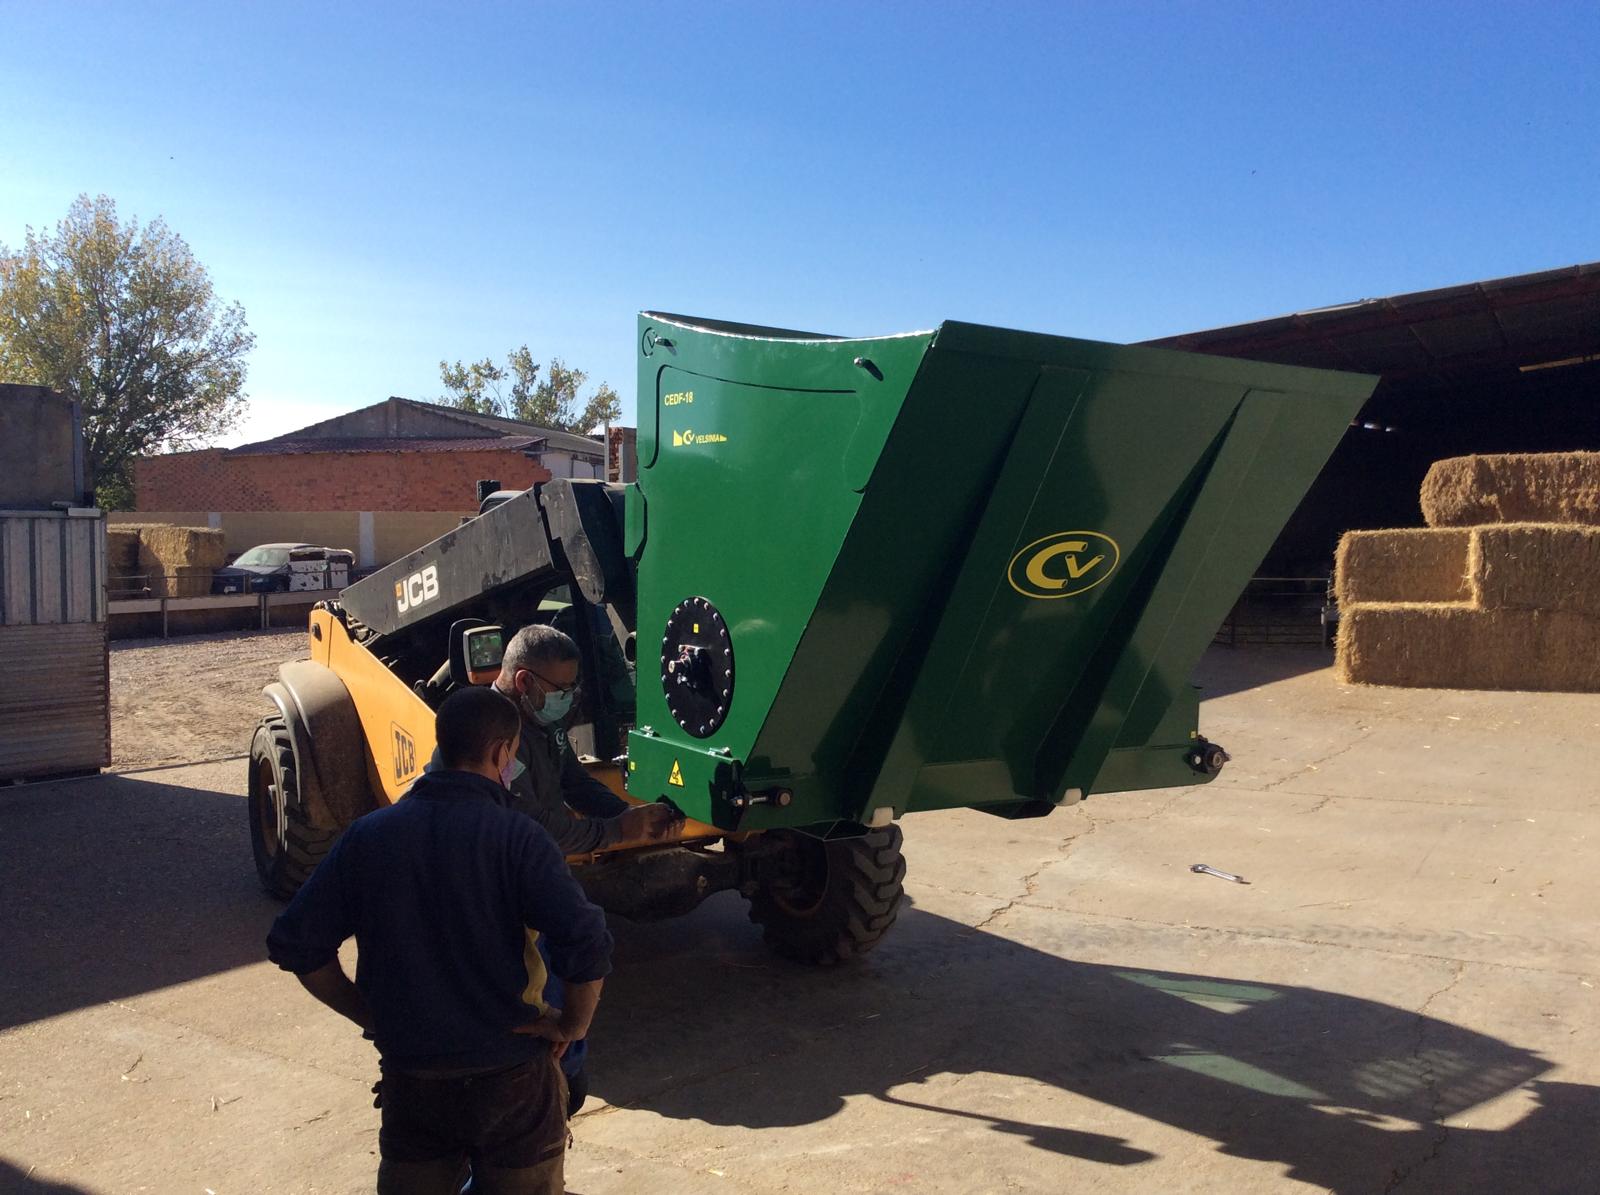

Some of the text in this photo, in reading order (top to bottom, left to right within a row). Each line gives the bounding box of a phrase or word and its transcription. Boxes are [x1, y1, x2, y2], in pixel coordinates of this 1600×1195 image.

[664, 391, 694, 406] CEDF-18
[395, 565, 439, 613] JCB
[395, 730, 415, 779] JCB
